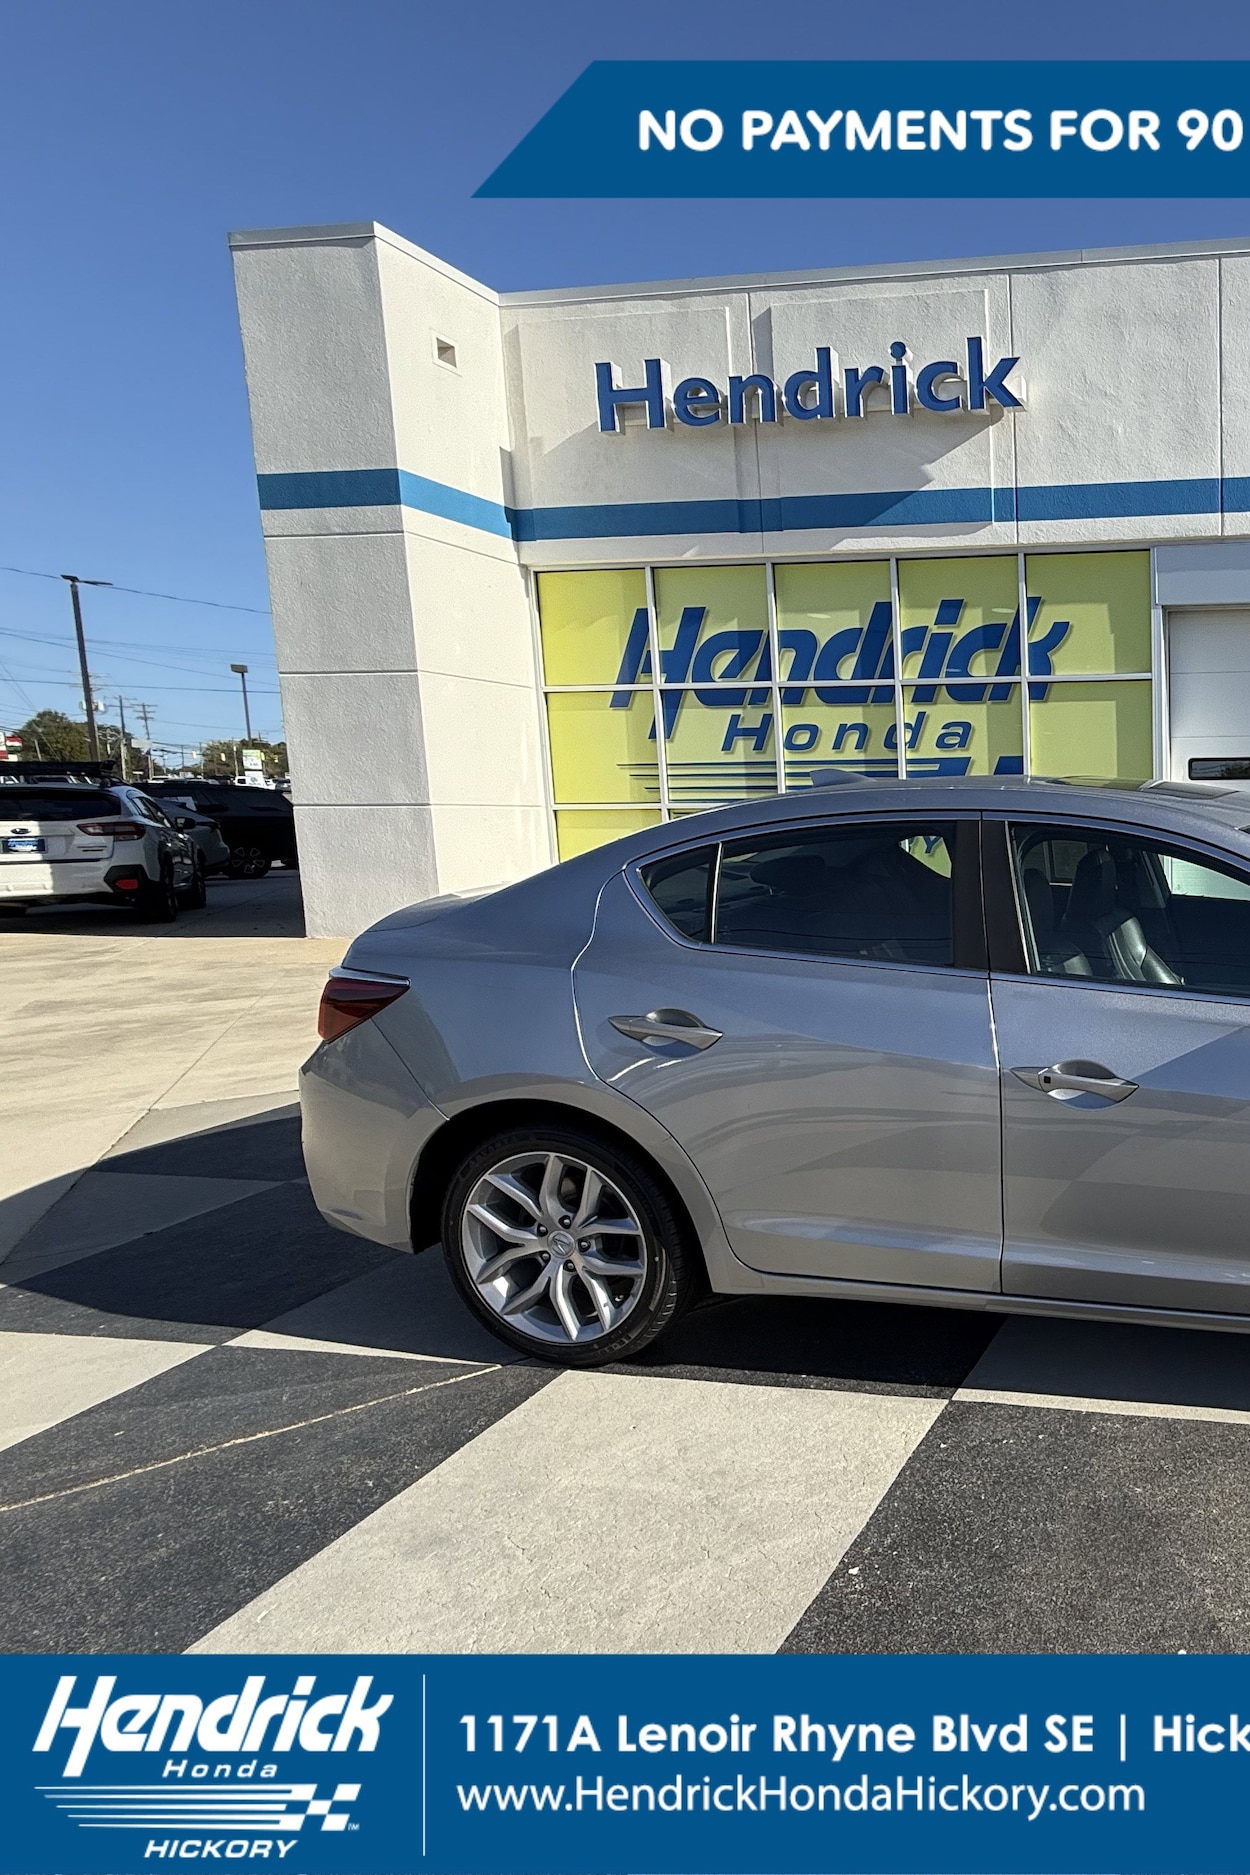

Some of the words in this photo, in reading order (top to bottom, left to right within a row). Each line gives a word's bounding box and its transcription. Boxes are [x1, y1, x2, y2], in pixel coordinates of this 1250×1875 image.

[595, 336, 1025, 433] Hendrick
[609, 596, 1071, 740] Hendrick
[721, 711, 973, 752] Honda
